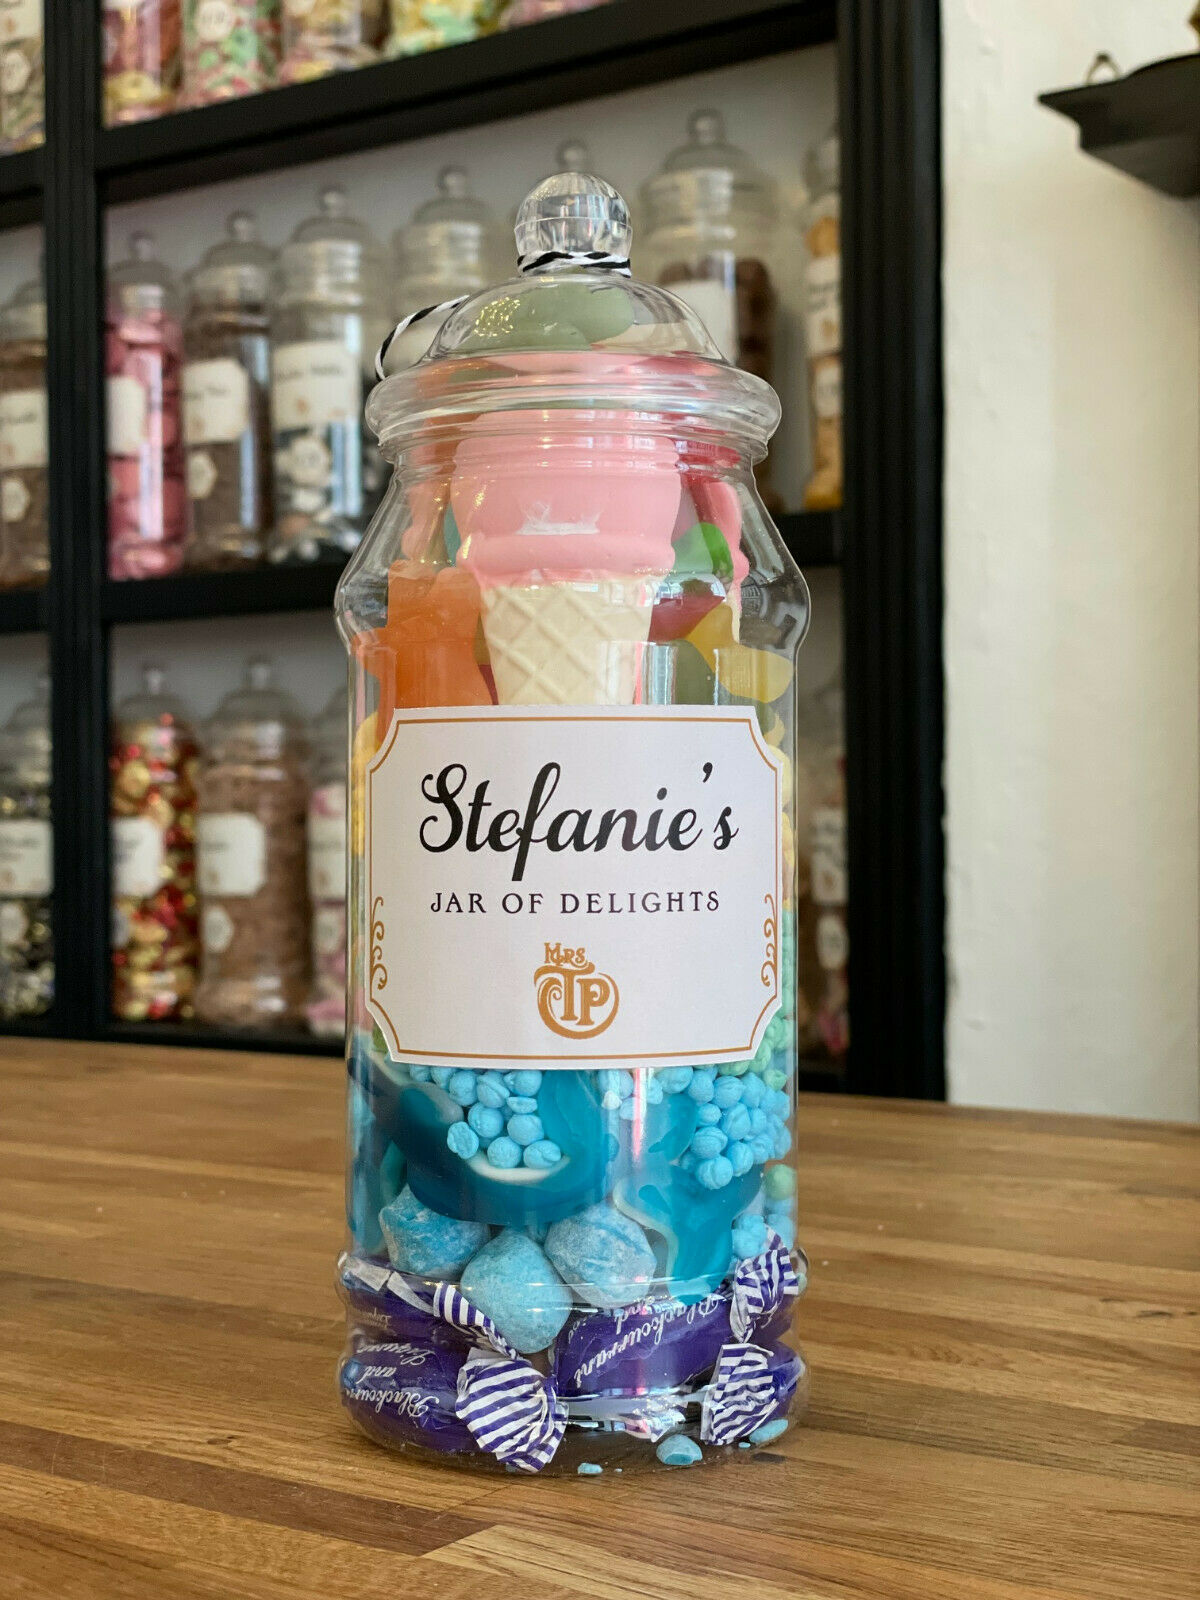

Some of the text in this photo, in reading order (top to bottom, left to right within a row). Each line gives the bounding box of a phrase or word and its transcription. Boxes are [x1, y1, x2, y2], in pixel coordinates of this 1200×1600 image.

[420, 762, 739, 881] Stefanie's
[431, 891, 719, 914] JAR OF DELIGHTS
